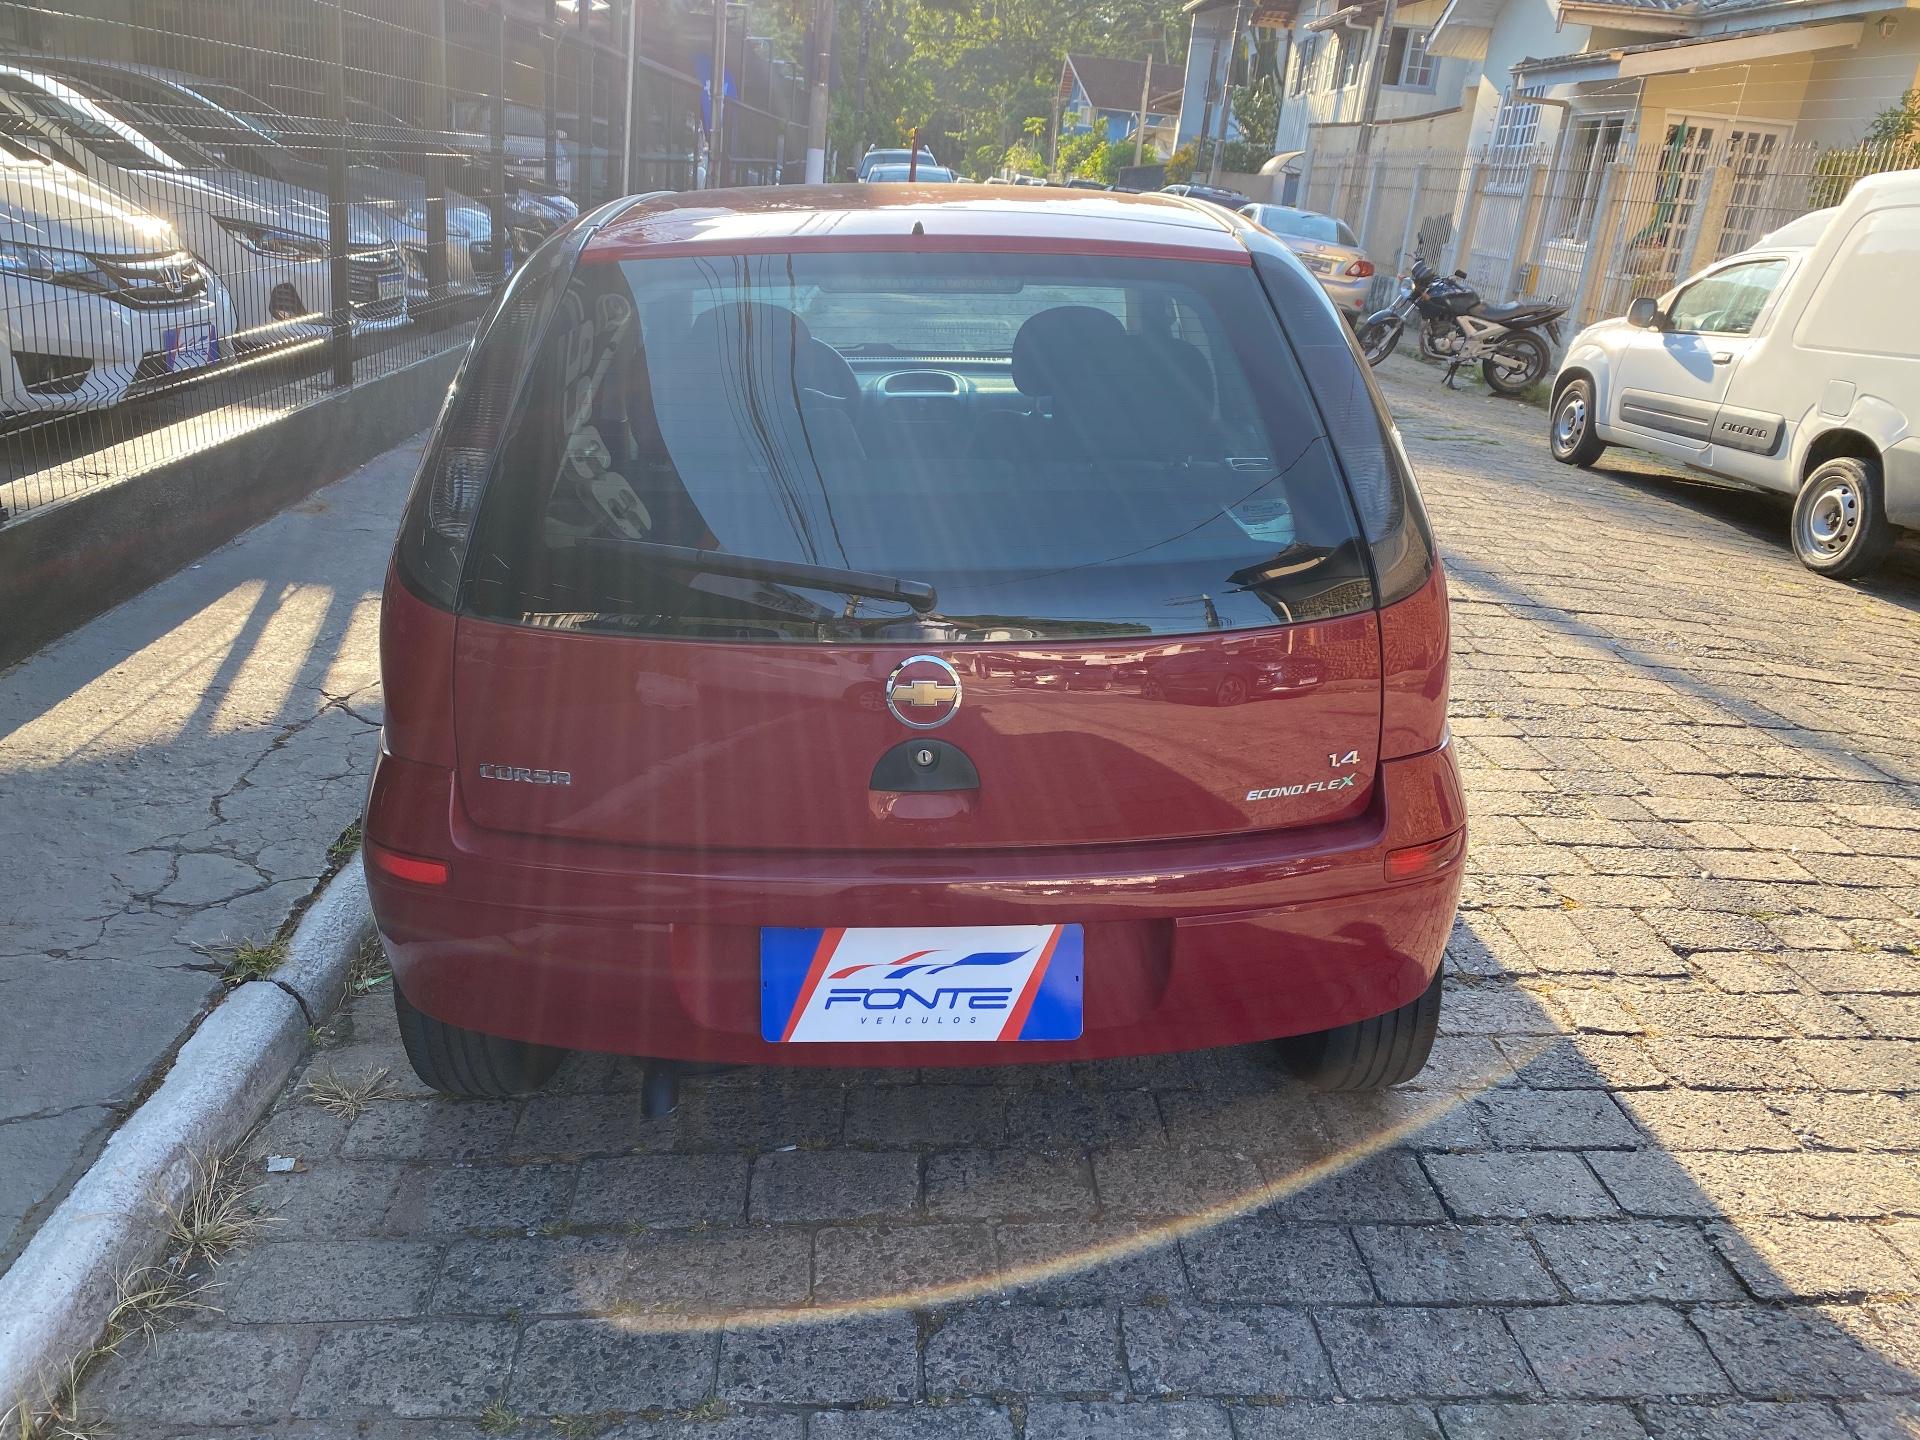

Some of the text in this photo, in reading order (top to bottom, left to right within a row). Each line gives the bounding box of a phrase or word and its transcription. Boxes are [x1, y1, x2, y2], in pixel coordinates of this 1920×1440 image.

[1328, 750, 1360, 768] 1.4
[480, 763, 570, 785] CORSA
[1246, 772, 1356, 801] ECONO.FLEX
[825, 987, 1012, 1010] FONTE
[861, 1015, 977, 1025] VEÍCULOS
